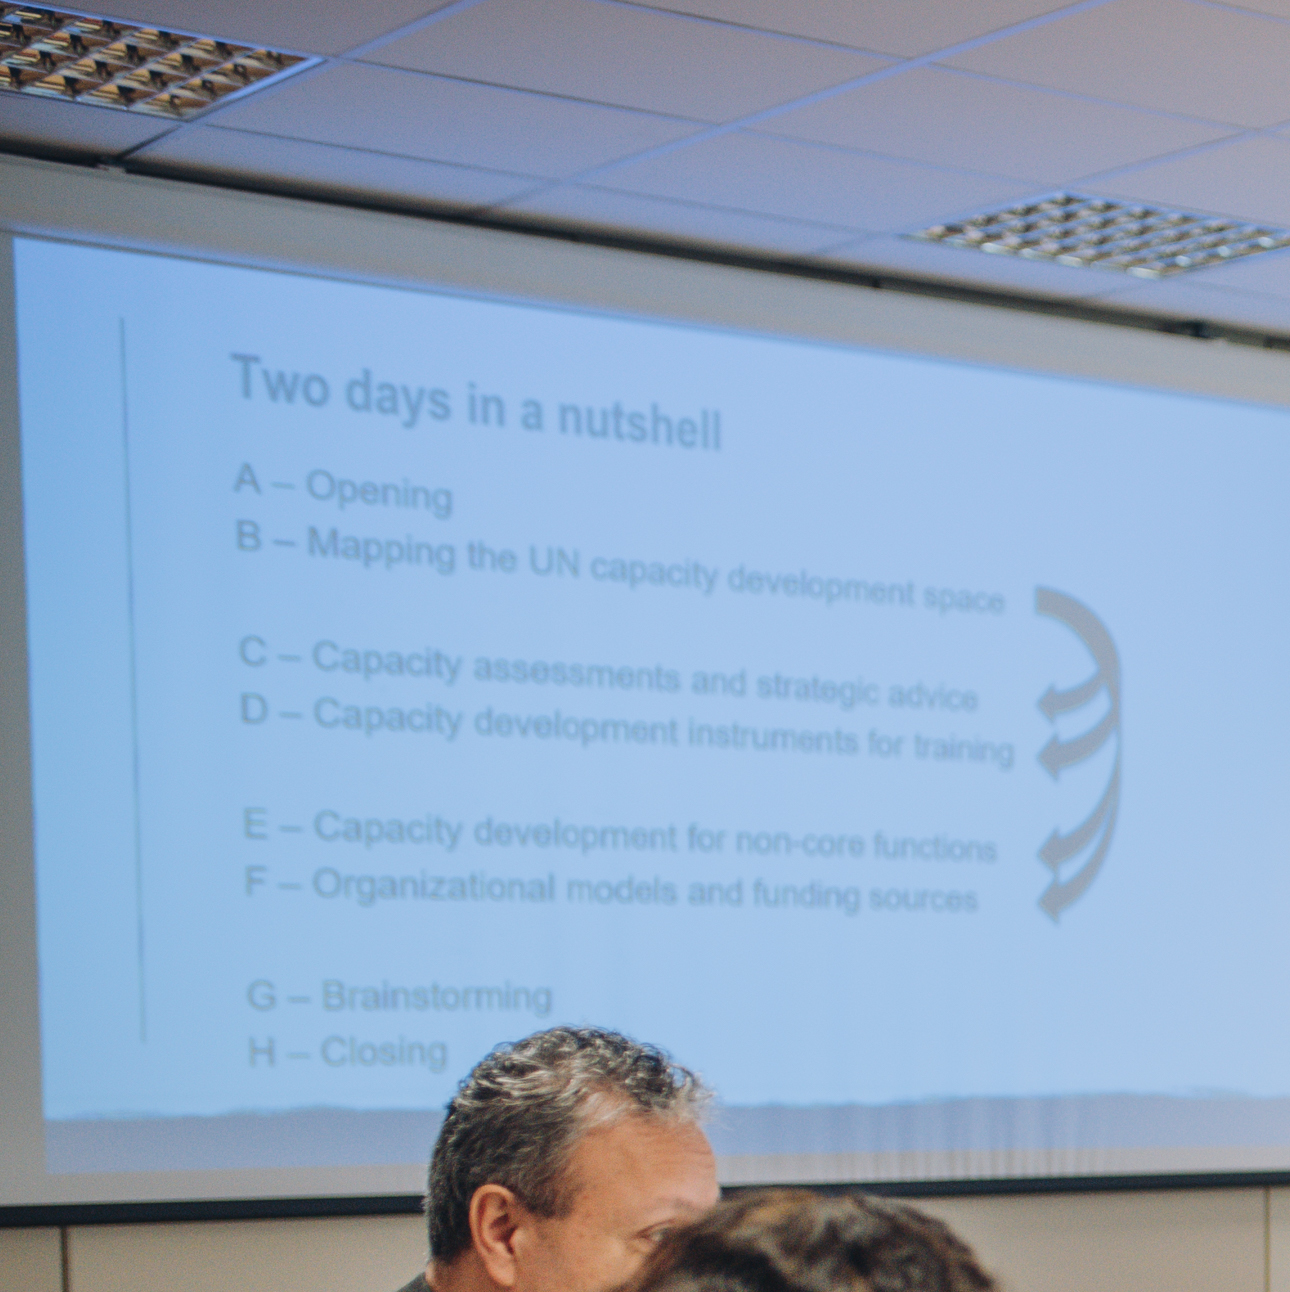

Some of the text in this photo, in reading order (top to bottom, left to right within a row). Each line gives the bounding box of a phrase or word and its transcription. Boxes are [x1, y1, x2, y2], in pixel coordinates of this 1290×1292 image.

[230, 352, 723, 452] Two days in a nutshell
[233, 463, 262, 495] A
[305, 469, 453, 519] Opening
[235, 520, 263, 553] B
[307, 526, 455, 575] Mapping
[467, 540, 519, 575] the
[529, 546, 580, 579] UN
[590, 551, 718, 596] capacity
[727, 563, 915, 614] development
[924, 582, 1004, 618] space
[238, 636, 268, 669] C
[313, 641, 462, 684] Capacity
[473, 654, 682, 694] assessments
[691, 665, 748, 698] and
[755, 669, 880, 713] strategic
[887, 679, 978, 713] advice
[240, 693, 269, 725] D
[313, 698, 462, 742] Capacity
[473, 707, 680, 748] development
[687, 718, 859, 757] instruments
[867, 726, 905, 759] for
[914, 734, 1014, 771] training
[243, 809, 268, 841] E
[313, 811, 462, 851] Capacity
[473, 817, 679, 855] development
[687, 822, 727, 853] for
[736, 828, 865, 860] non-core
[873, 830, 997, 864] functions
[245, 867, 269, 898] F
[312, 867, 556, 906] Organizational
[566, 874, 679, 906] models
[688, 877, 744, 907] and
[753, 878, 860, 916] funding
[868, 886, 978, 914] sources
[246, 979, 277, 1012] G
[322, 981, 553, 1017] Brainstorming
[249, 1037, 276, 1068] H
[321, 1035, 448, 1073] Closing
